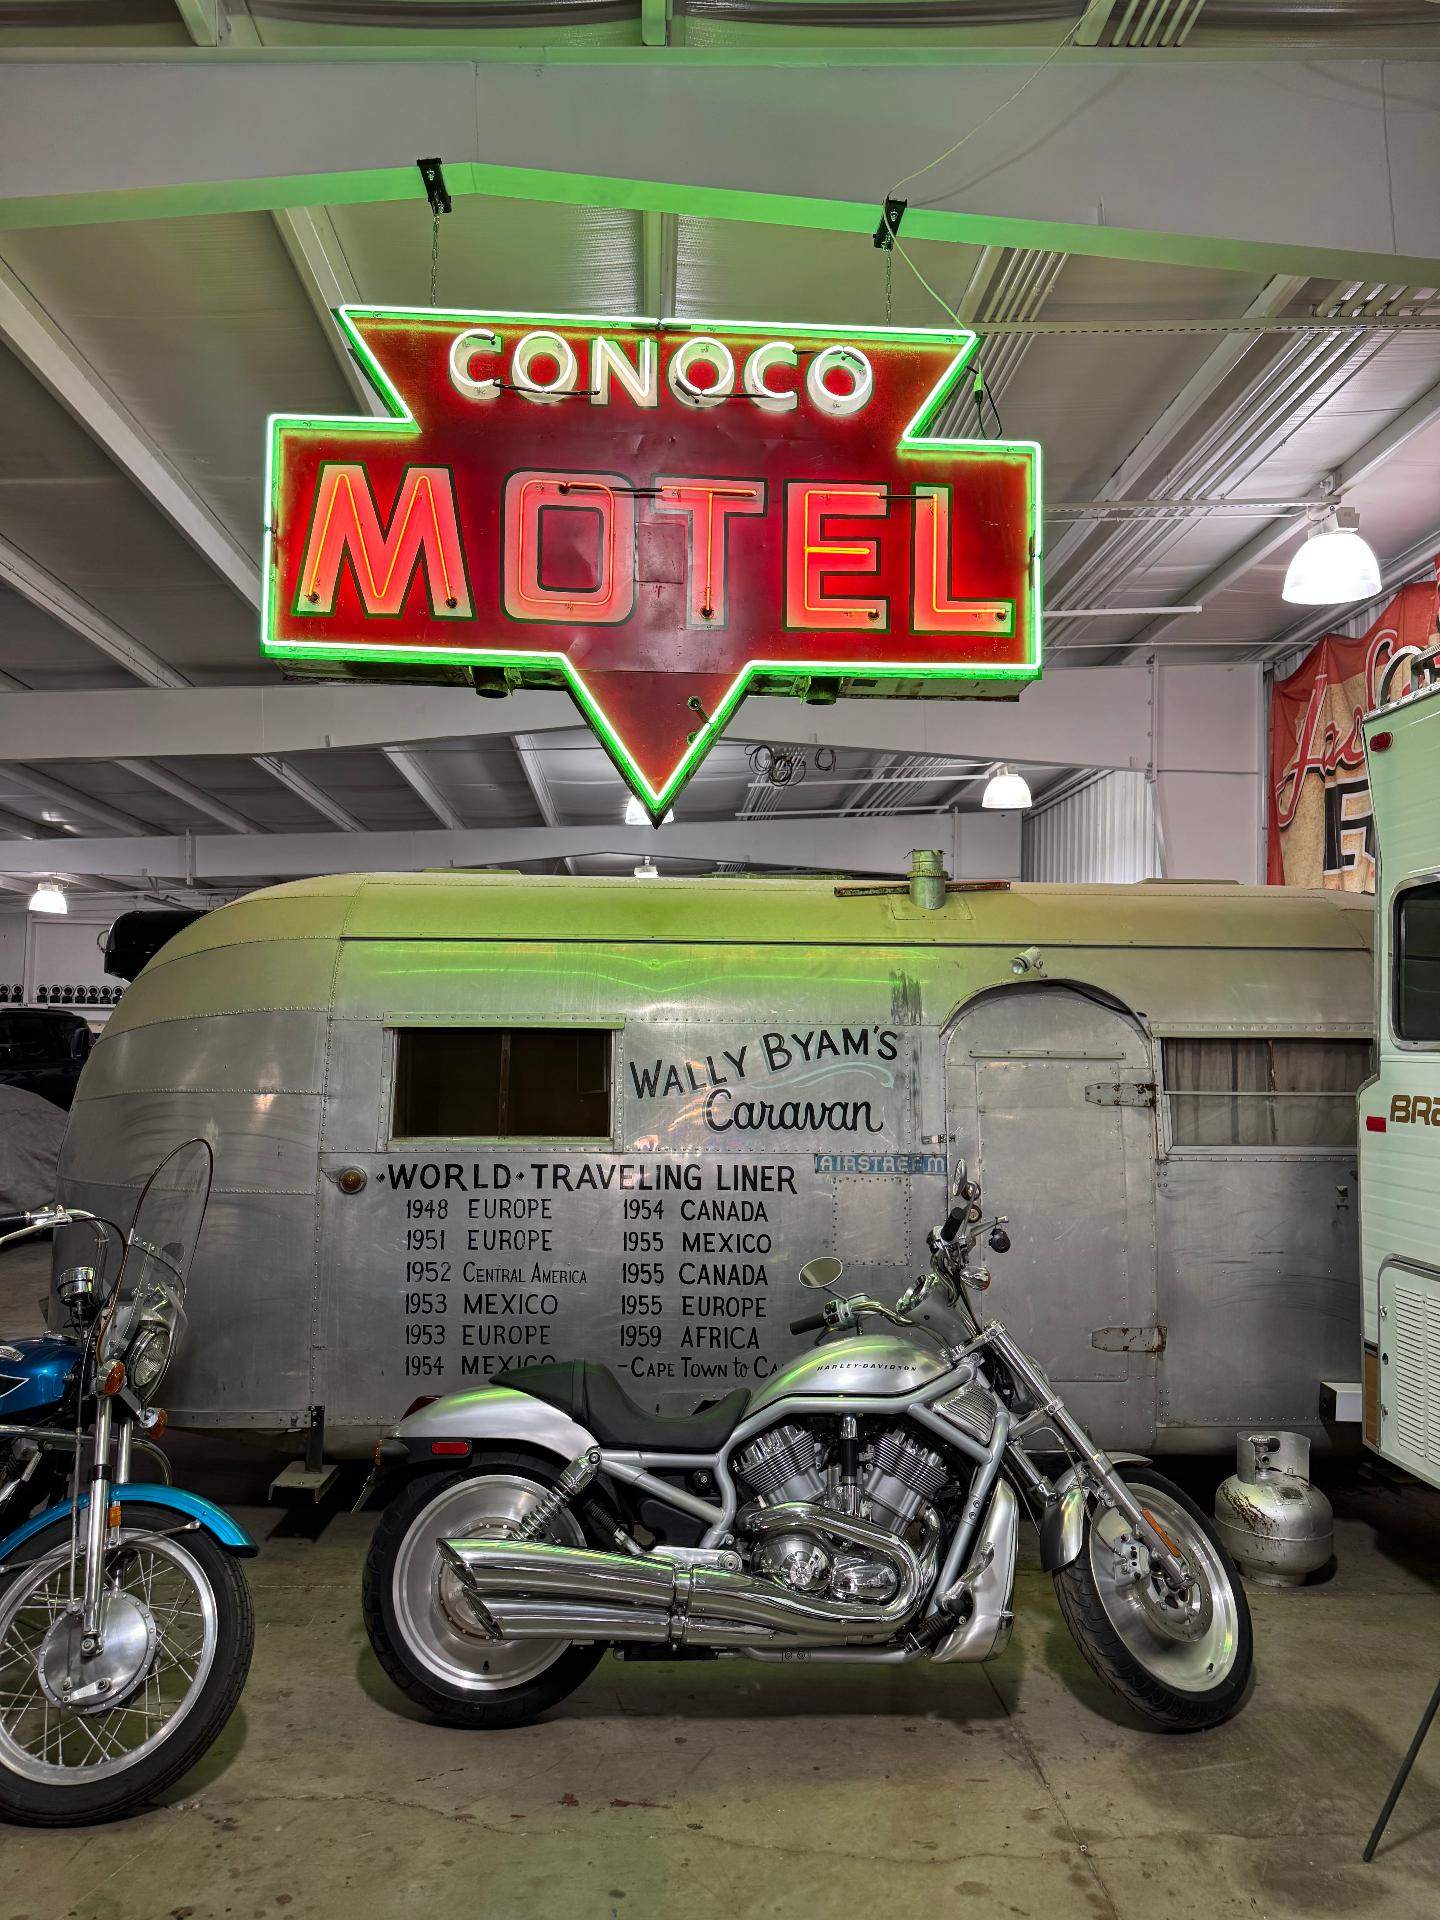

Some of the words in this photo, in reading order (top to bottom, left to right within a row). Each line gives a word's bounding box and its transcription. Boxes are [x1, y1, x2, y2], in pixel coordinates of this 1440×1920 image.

[448, 327, 874, 416] CONOCO
[291, 461, 1014, 635] MOTEL
[629, 1045, 748, 1099] WALLY
[761, 1025, 899, 1072] BYAM'S
[704, 1087, 884, 1133] Caravan
[386, 1162, 512, 1192] WORLD
[530, 1163, 702, 1193] TRAVELING
[716, 1164, 798, 1195] LINER
[405, 1198, 449, 1220] 1948
[467, 1198, 553, 1220] EUROPE
[622, 1198, 665, 1221] 1954
[679, 1199, 769, 1223] CANADA
[405, 1228, 446, 1251] 1951
[466, 1228, 553, 1252] EUROPE
[622, 1231, 665, 1254] 1955
[681, 1231, 772, 1255] MEXICO
[405, 1260, 452, 1283] 1952
[462, 1260, 526, 1284] CENTRAL
[530, 1261, 588, 1285] AMERICA
[621, 1262, 665, 1286] 1955
[678, 1262, 769, 1287] CANADA
[404, 1292, 448, 1316] 1953
[462, 1293, 559, 1316] MEXICO
[620, 1294, 663, 1317] 1955
[681, 1295, 768, 1319] EUROPE
[404, 1323, 447, 1346] 1953
[461, 1323, 552, 1347] EUROPE
[619, 1324, 663, 1348] 1959
[680, 1325, 761, 1351] AFRICA
[404, 1355, 445, 1377] 1954
[680, 1356, 728, 1378] TOWN
[732, 1356, 750, 1378] to
[816, 1362, 917, 1372] HARLEY-DAVIDSON
